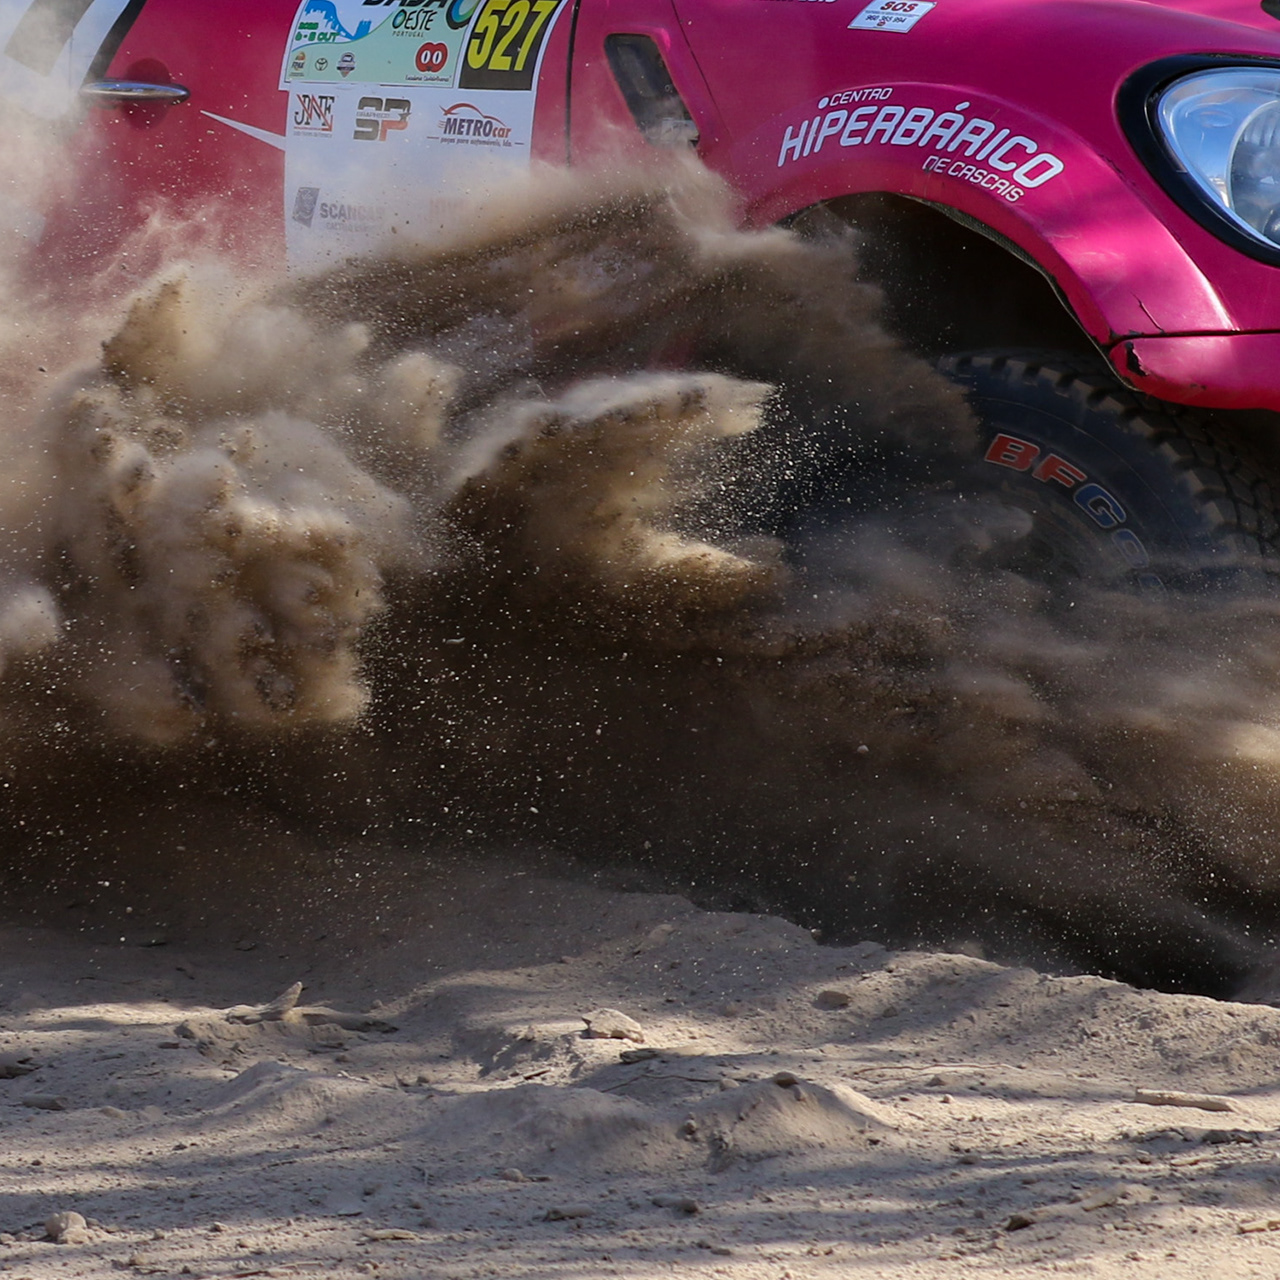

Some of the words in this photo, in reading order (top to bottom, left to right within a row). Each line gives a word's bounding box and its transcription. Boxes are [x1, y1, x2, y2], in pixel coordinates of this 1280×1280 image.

[879, 0, 919, 13] SOS
[391, 8, 439, 31] OESTE
[829, 87, 893, 107] CENTRO
[777, 98, 1064, 189] HIPERBÁRICO
[922, 155, 951, 173] DE
[948, 160, 1025, 202] CASCAIS
